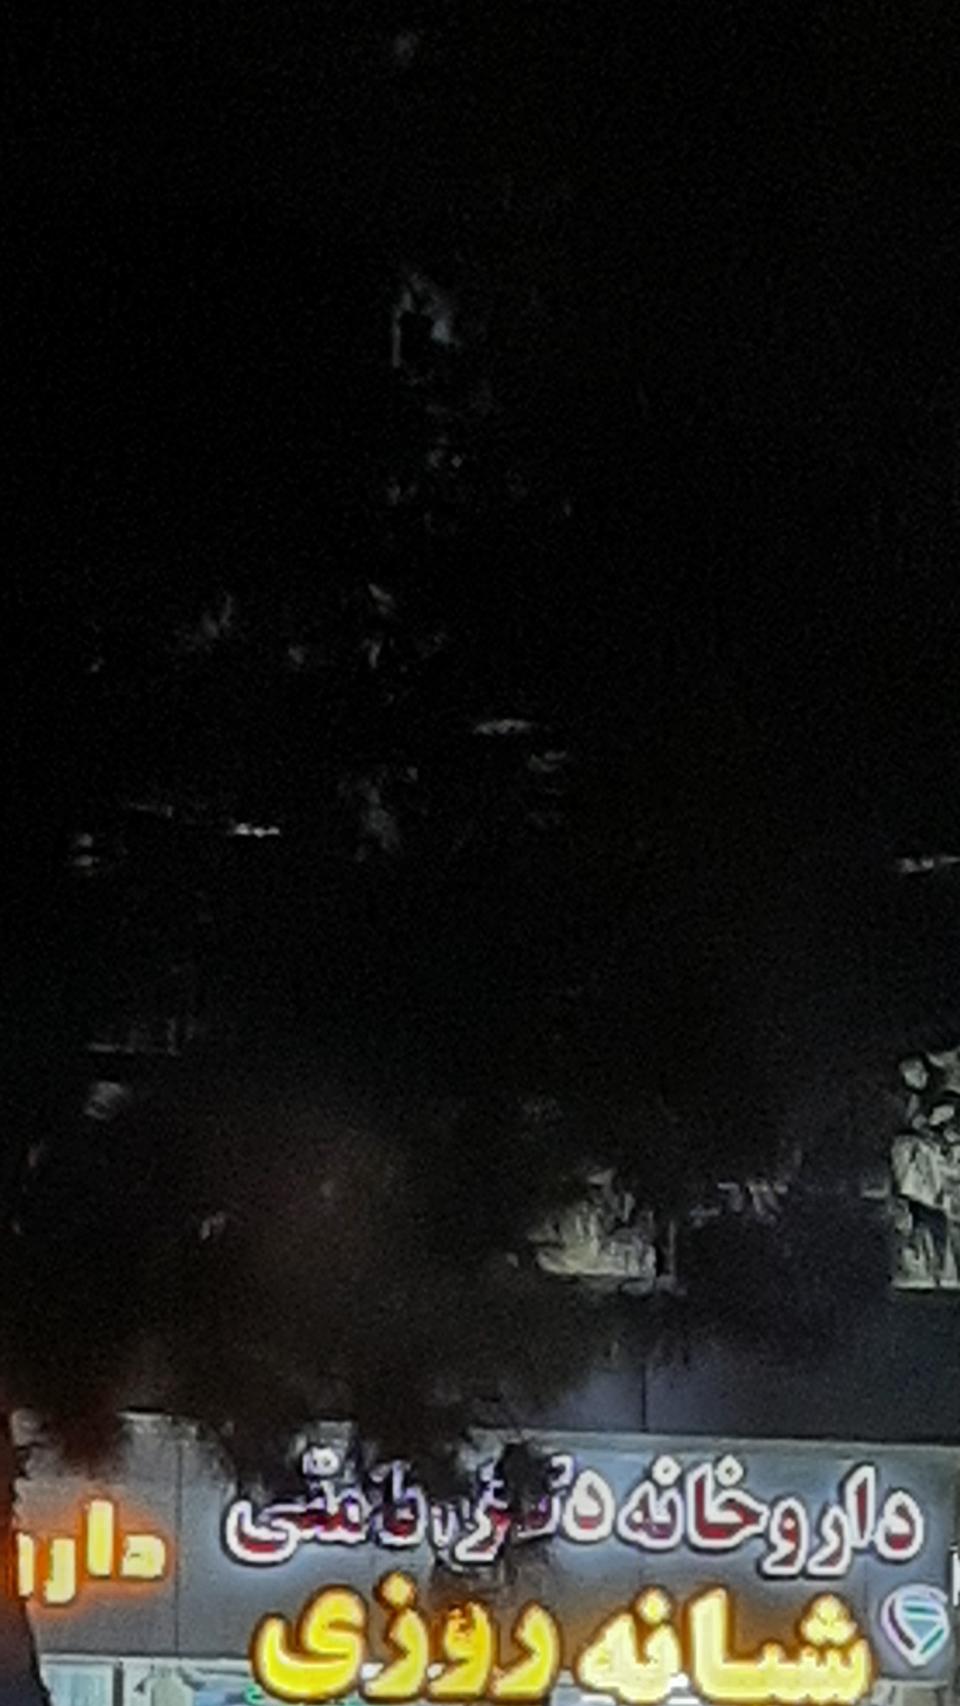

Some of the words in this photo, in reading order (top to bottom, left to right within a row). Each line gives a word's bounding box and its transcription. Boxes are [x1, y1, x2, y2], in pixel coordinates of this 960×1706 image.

[454, 1464, 615, 1563] دکر
[617, 1453, 924, 1576] داروخانه
[252, 1572, 562, 1702] روزی
